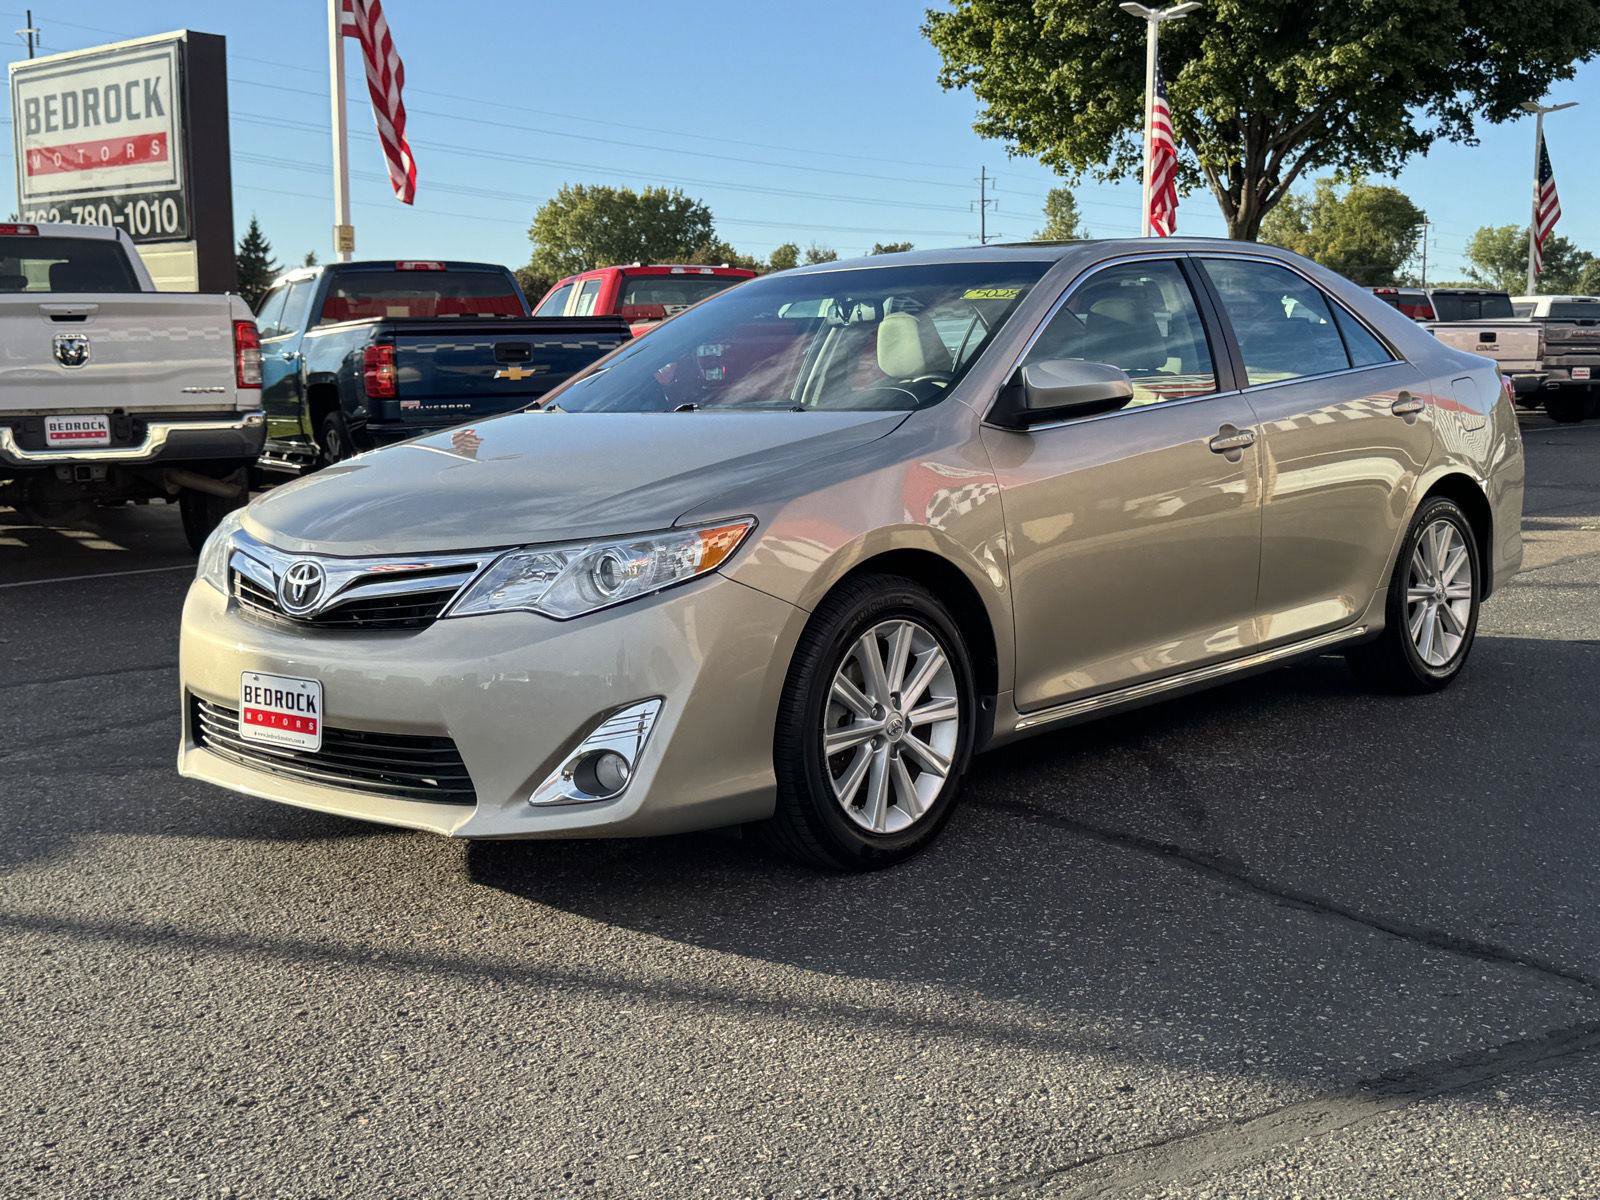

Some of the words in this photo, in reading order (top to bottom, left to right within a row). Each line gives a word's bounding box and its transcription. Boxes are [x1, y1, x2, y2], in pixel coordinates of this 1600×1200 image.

[24, 76, 165, 136] BEDROCK
[32, 140, 160, 169] MOTORS
[49, 421, 106, 431] BEDROCK
[244, 685, 317, 713] BEDROCK
[246, 712, 314, 730] MOTORS
